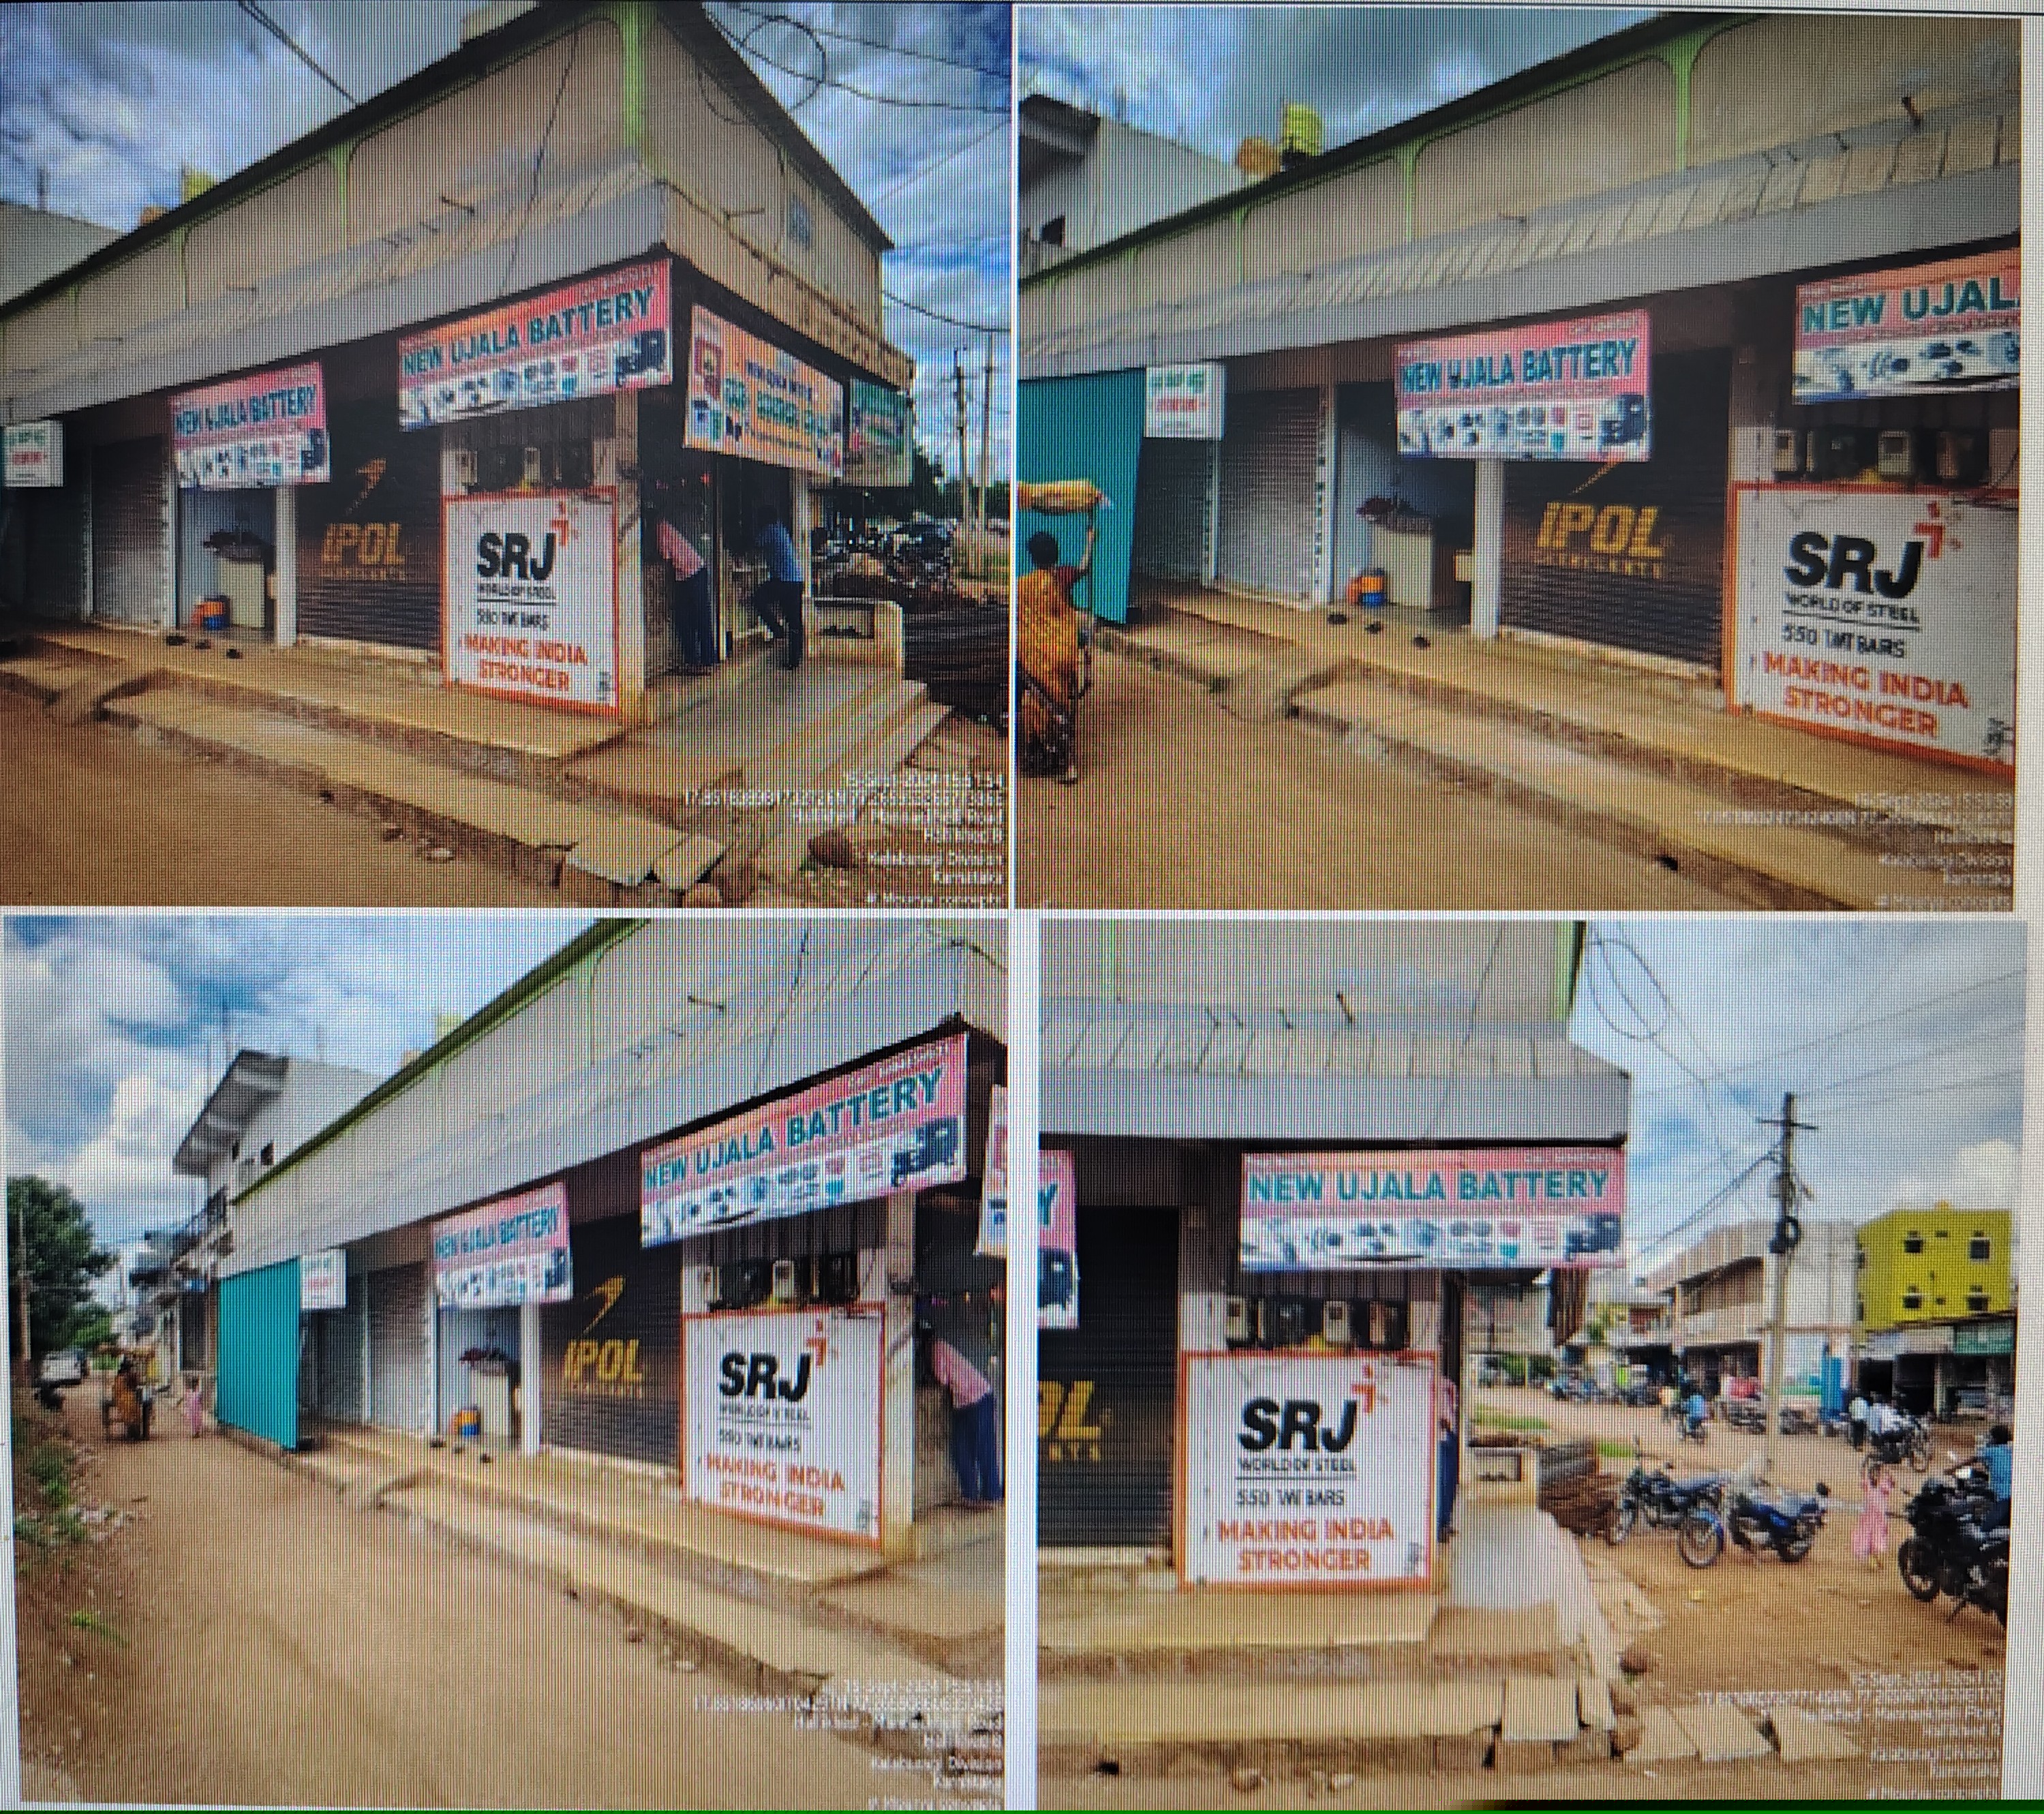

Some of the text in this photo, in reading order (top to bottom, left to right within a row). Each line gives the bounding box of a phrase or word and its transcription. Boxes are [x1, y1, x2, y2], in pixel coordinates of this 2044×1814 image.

[1802, 294, 1886, 333] NEW
[1902, 276, 2020, 320] UJAL
[403, 286, 654, 374] NEW UJALA BATTERY
[1401, 338, 1638, 393] NEW UJALA BATTERY
[249, 384, 316, 422] BATTERY
[477, 532, 557, 581] SRJ
[1784, 531, 1924, 599] SRJ
[1785, 591, 1919, 623] WORLD OF STEEL
[464, 633, 588, 666] MAKING INDIA
[1782, 624, 1817, 646] 550
[1858, 633, 1906, 659] BARS
[479, 662, 570, 691] STRONGER
[1763, 651, 1968, 709] MAKING INDIA
[1784, 685, 1938, 738] STRONGER
[644, 1067, 942, 1190] NEW UJALA BATTERY
[1249, 1168, 1608, 1202] NEW UJALA BATTERY
[718, 1350, 811, 1402] SRJ
[1238, 1395, 1358, 1453] SRJ
[706, 1453, 845, 1492] MAKING INDIA
[1238, 1457, 1356, 1472] WORLD OF STEEL
[720, 1482, 825, 1516] STRONGER
[1237, 1489, 1269, 1506] 550
[1306, 1489, 1345, 1506] BARS
[1217, 1517, 1394, 1543] MAKING INDIA
[1238, 1548, 1371, 1573] STRONGER
